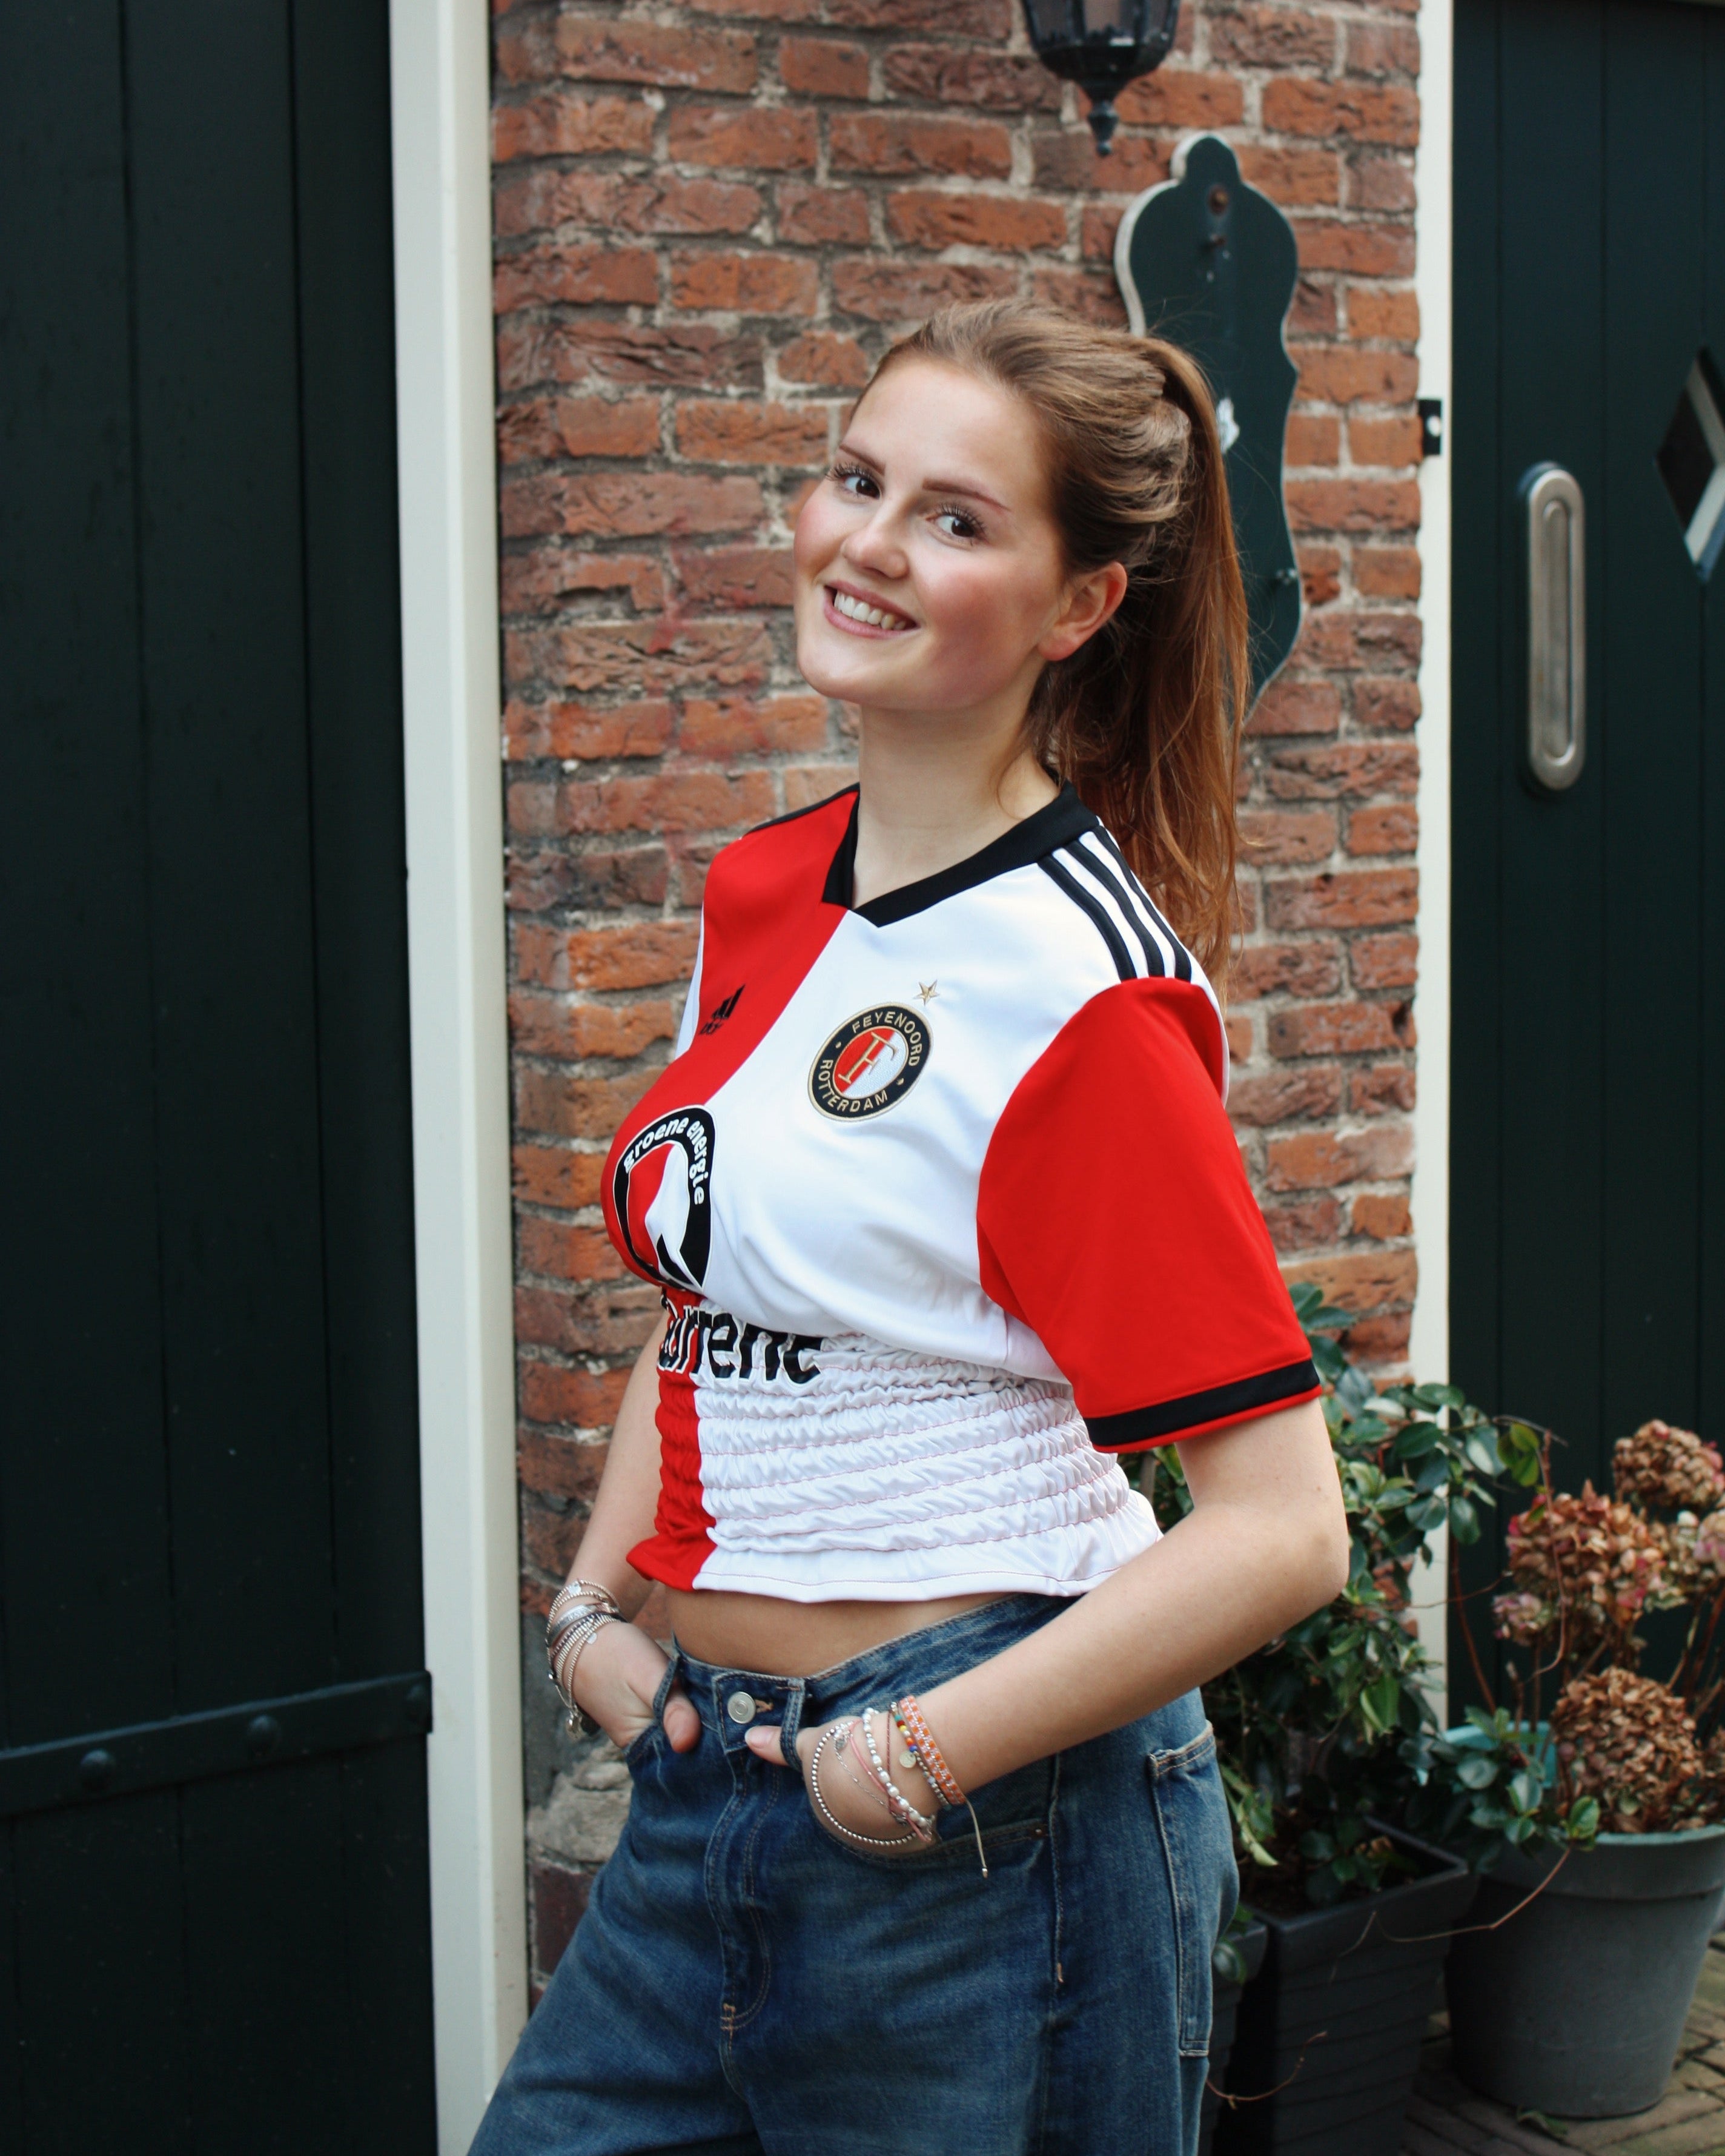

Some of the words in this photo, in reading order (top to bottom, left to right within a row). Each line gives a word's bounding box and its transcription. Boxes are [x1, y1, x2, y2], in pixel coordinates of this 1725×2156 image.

[852, 1011, 922, 1066] FEYENOORD
[818, 1059, 888, 1113] ROTTERDAM
[623, 1117, 689, 1174] groene
[686, 1120, 709, 1205] energie
